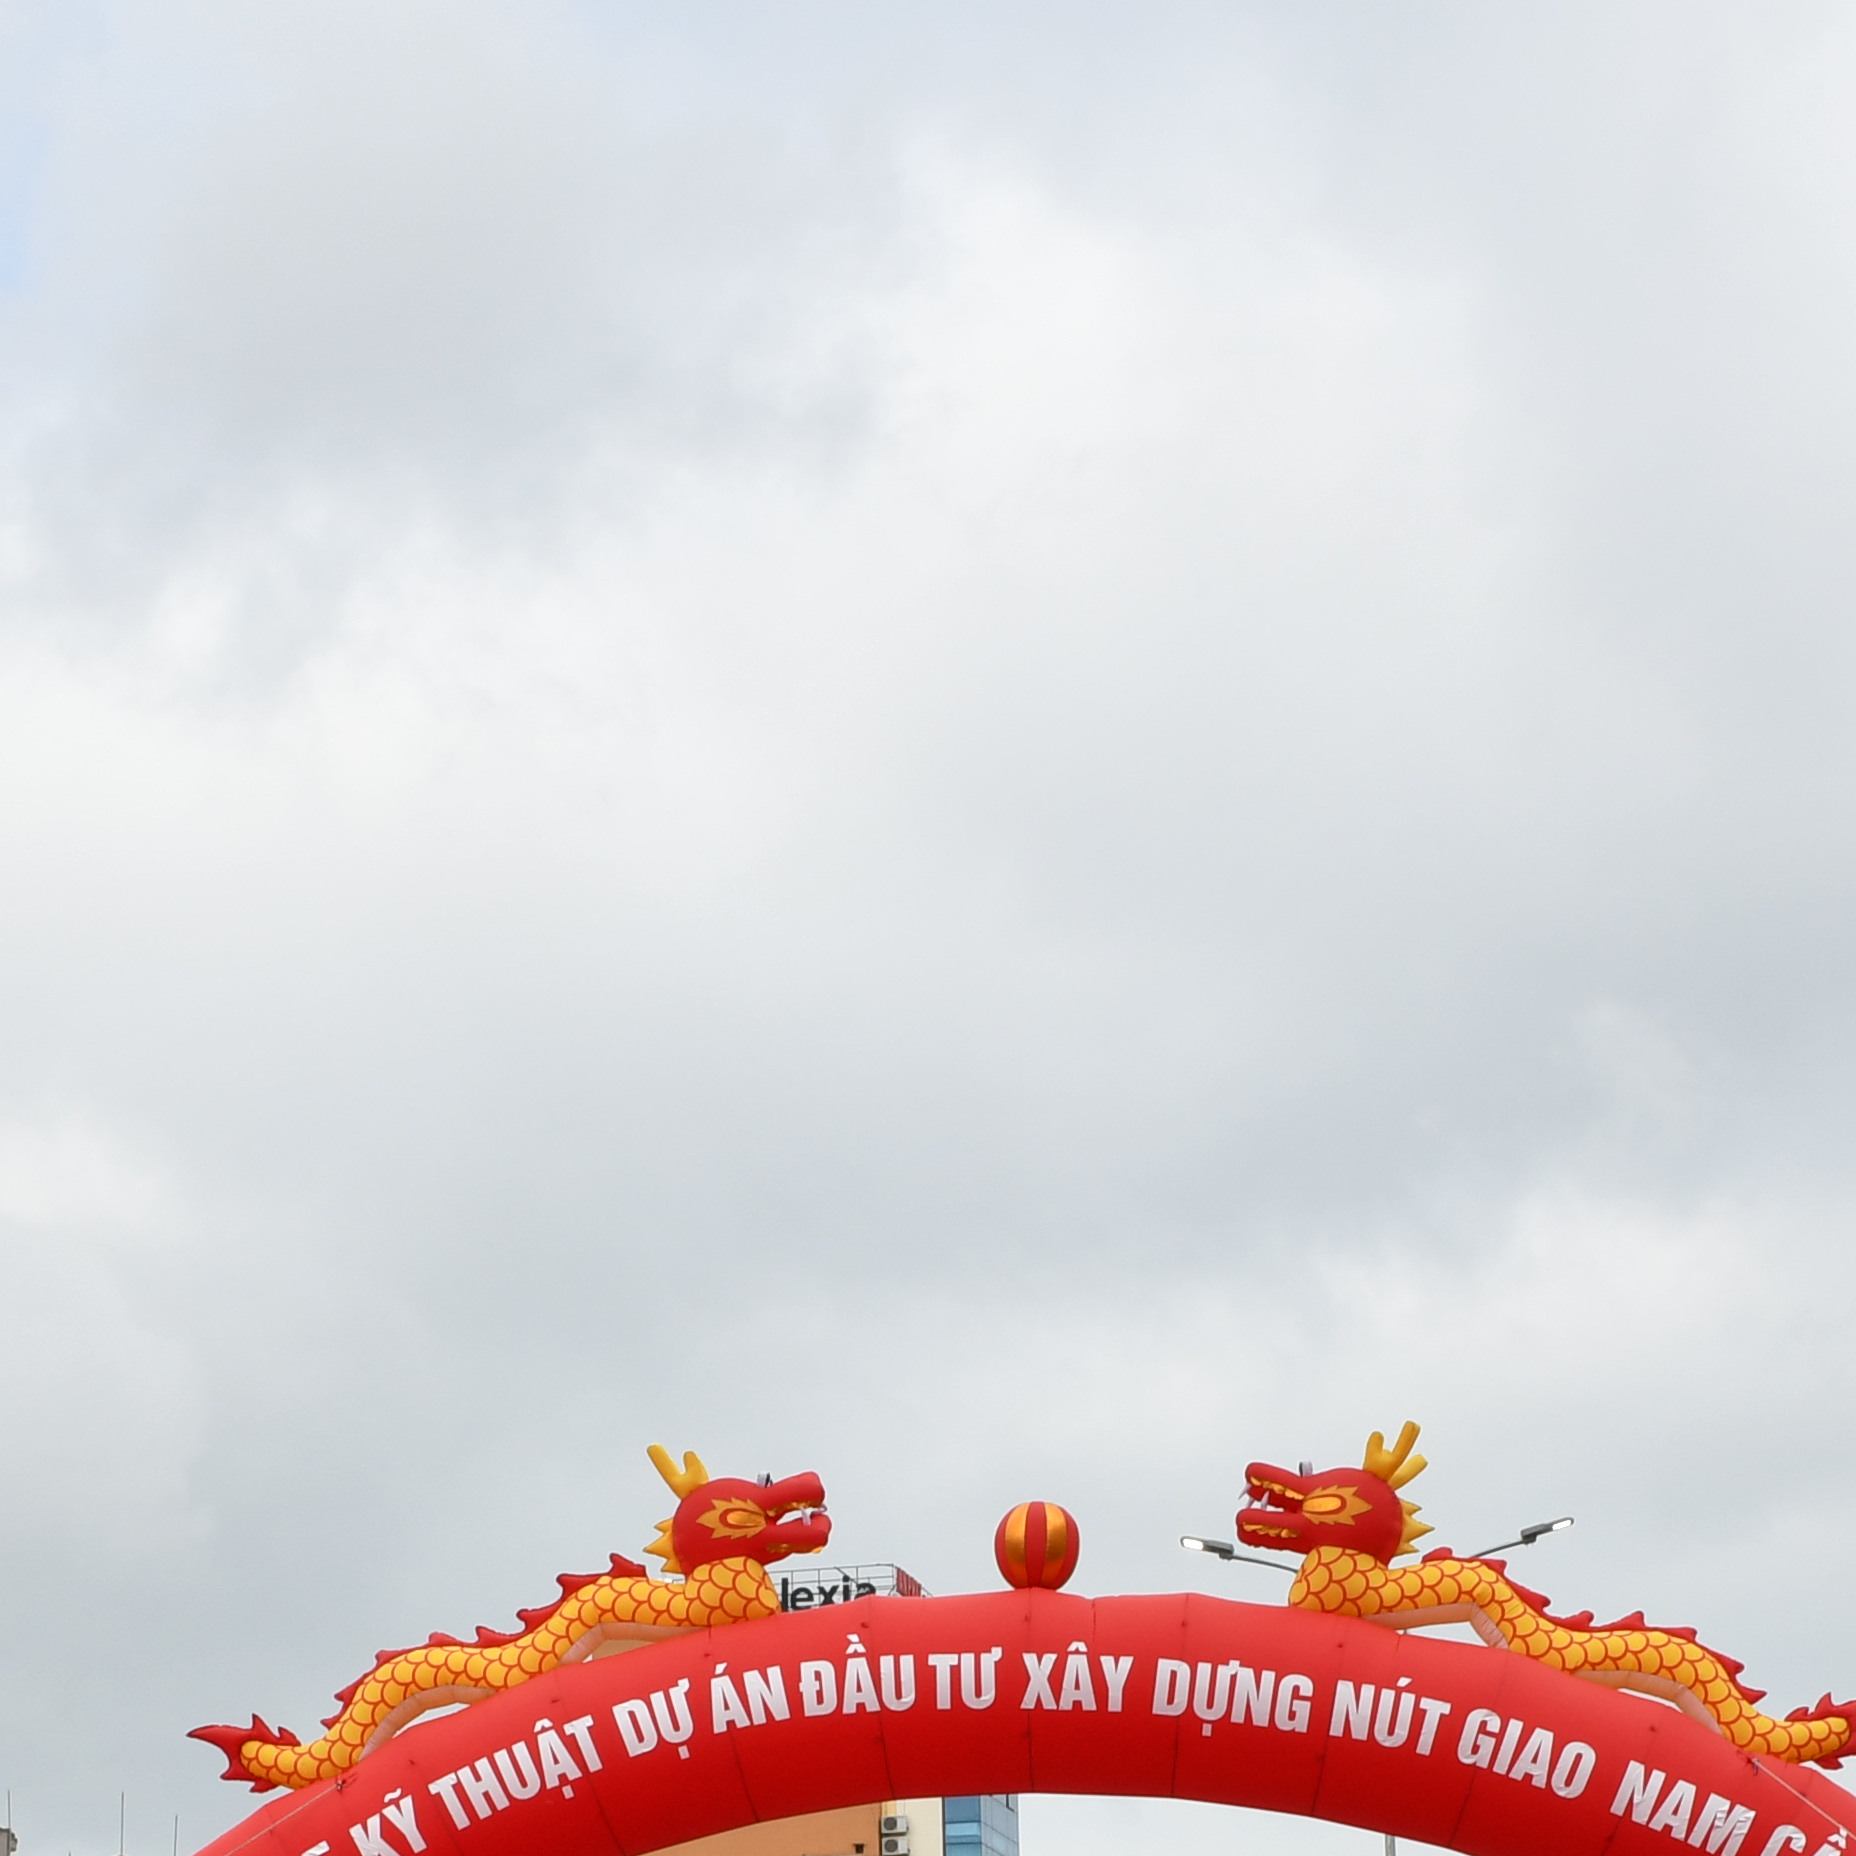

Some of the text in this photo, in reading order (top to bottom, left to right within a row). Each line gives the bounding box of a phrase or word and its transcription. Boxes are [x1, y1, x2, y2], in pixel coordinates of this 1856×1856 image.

[427, 1714, 604, 1831] THUẬT
[612, 1678, 695, 1760] DỰ
[709, 1662, 792, 1735] ÁN
[799, 1634, 915, 1717] ĐẦU
[927, 1647, 1003, 1711] TƯ
[1020, 1640, 1135, 1713] XÂY
[1151, 1657, 1314, 1738] DỰNG
[1328, 1676, 1451, 1757] NÚT
[1456, 1707, 1597, 1800] GIAO
